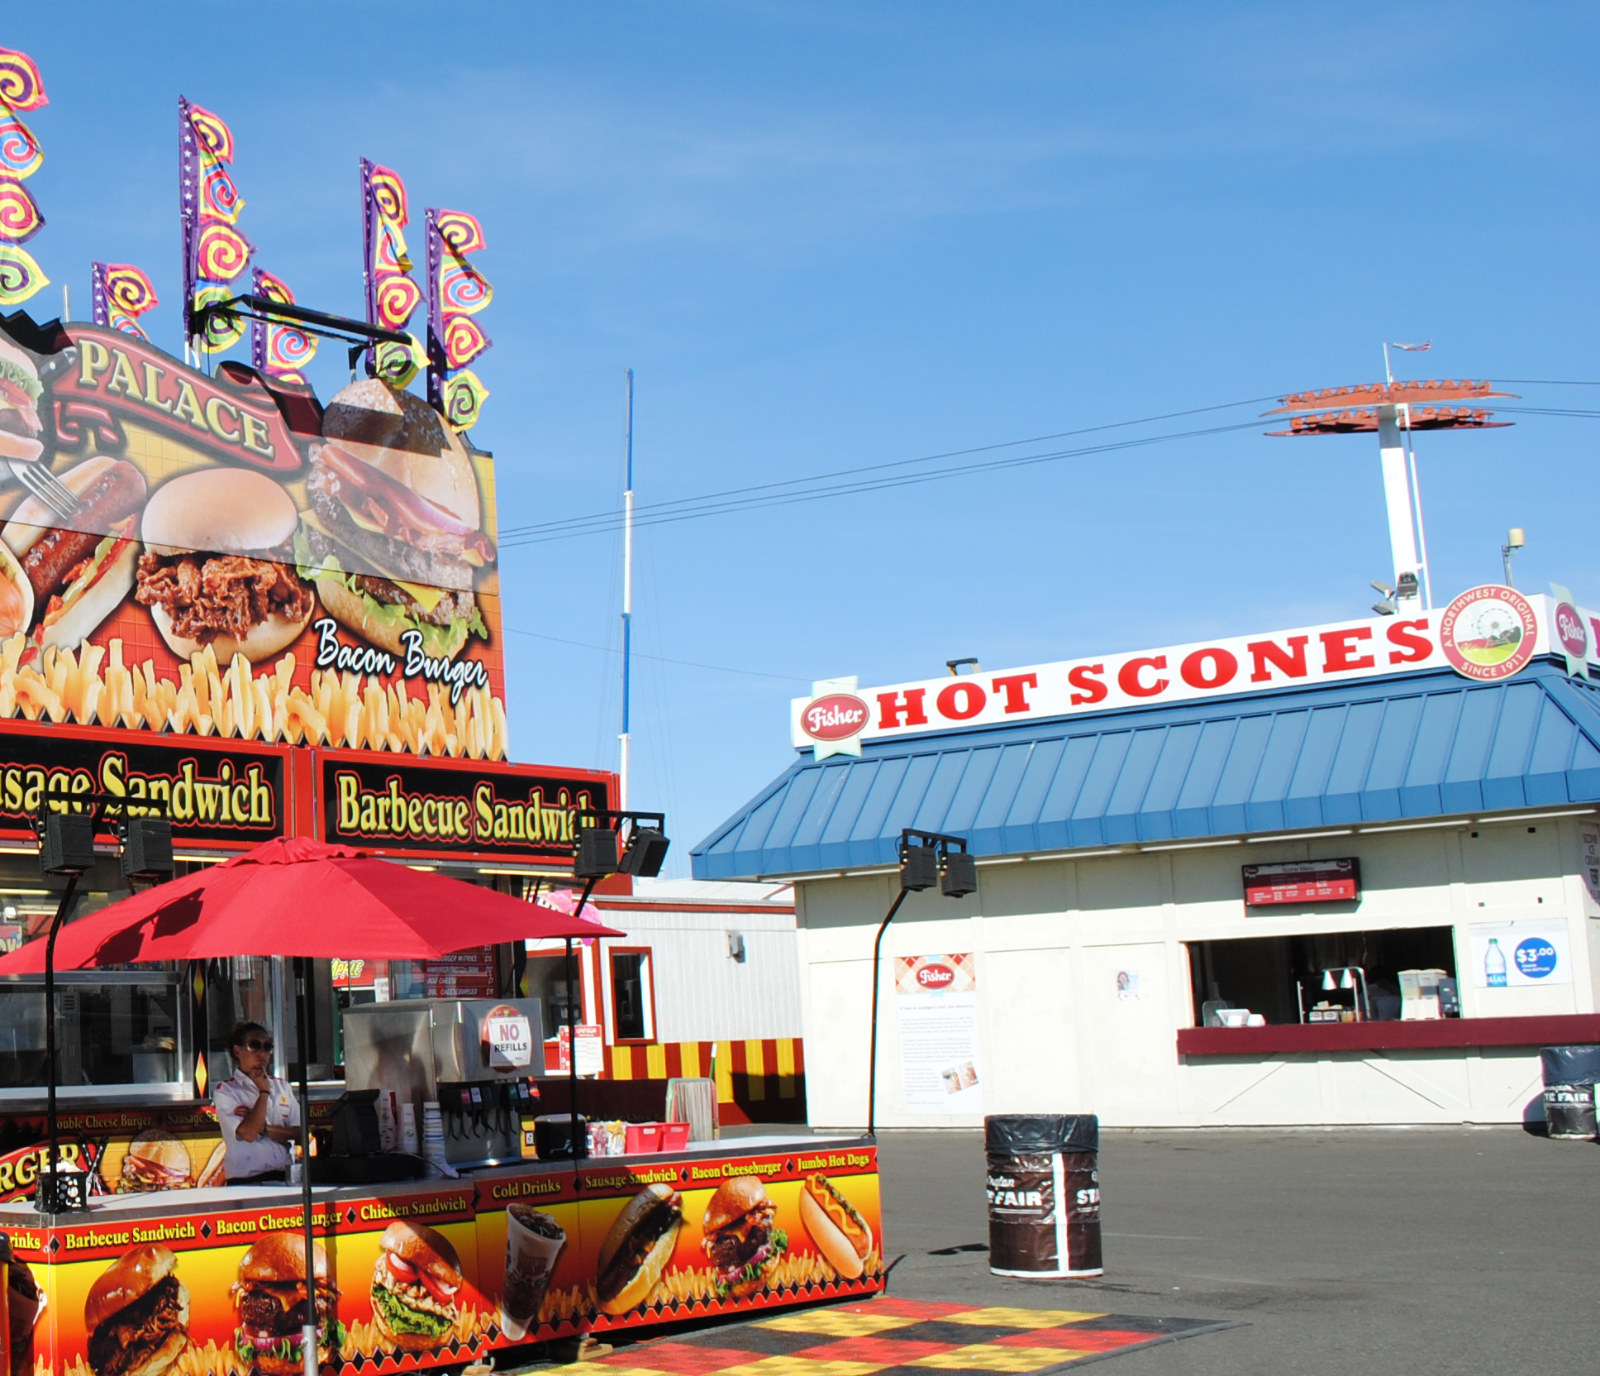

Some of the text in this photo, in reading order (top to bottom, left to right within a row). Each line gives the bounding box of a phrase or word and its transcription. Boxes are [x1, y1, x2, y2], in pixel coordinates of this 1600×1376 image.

[78, 339, 275, 460] PALACE
[1443, 588, 1496, 636] NORTHWEST
[1500, 590, 1535, 636] ORIGINAL
[1558, 613, 1585, 643] Fisher
[314, 618, 488, 705] Bacon Burger
[1461, 653, 1524, 677] SINCE 1911
[876, 617, 1434, 730] HOT SCONES
[808, 703, 864, 733] Fisher
[102, 755, 272, 825] Sandwich
[338, 771, 470, 838] Barbecue
[1516, 946, 1554, 963] $3.00
[919, 969, 952, 985] Fisher
[499, 1024, 520, 1041] NO
[494, 1042, 527, 1052] REFILLS
[1557, 1092, 1590, 1102] FAIR
[56, 1114, 151, 1130] ouble Cheese Burger
[167, 1112, 202, 1126] Sausage
[691, 1161, 782, 1180] Bacon Cheeseburger
[797, 1154, 870, 1172] Jumbo Hot Dogs
[492, 1180, 561, 1199] Cold Drinks
[585, 1167, 678, 1190] Sausage Sandwich
[360, 1198, 467, 1221] Chicken Sandwich
[995, 1190, 1043, 1206] FAIR
[216, 1211, 343, 1235] Bacon Cheeseurger
[9, 1236, 41, 1250] rinks
[65, 1224, 196, 1249] Barbecue Sandwich
